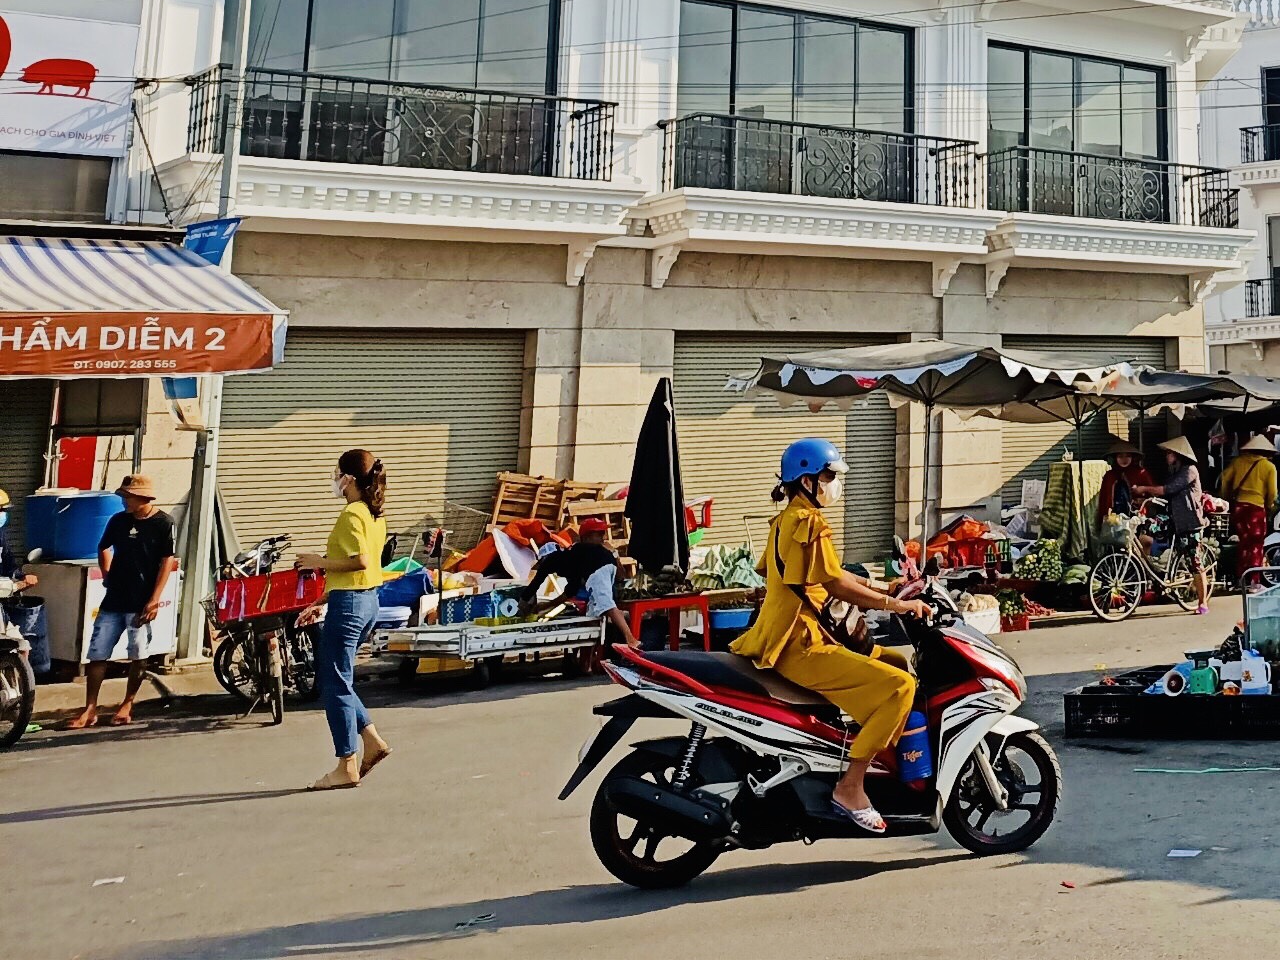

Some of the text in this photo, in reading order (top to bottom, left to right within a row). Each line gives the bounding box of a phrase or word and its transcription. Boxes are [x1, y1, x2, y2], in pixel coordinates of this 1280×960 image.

[49, 130, 66, 139] GIA
[99, 316, 195, 351] DIỄM
[204, 327, 226, 351] 2
[129, 360, 152, 368] 283
[154, 360, 177, 368] 555
[902, 750, 924, 762] Tiger
